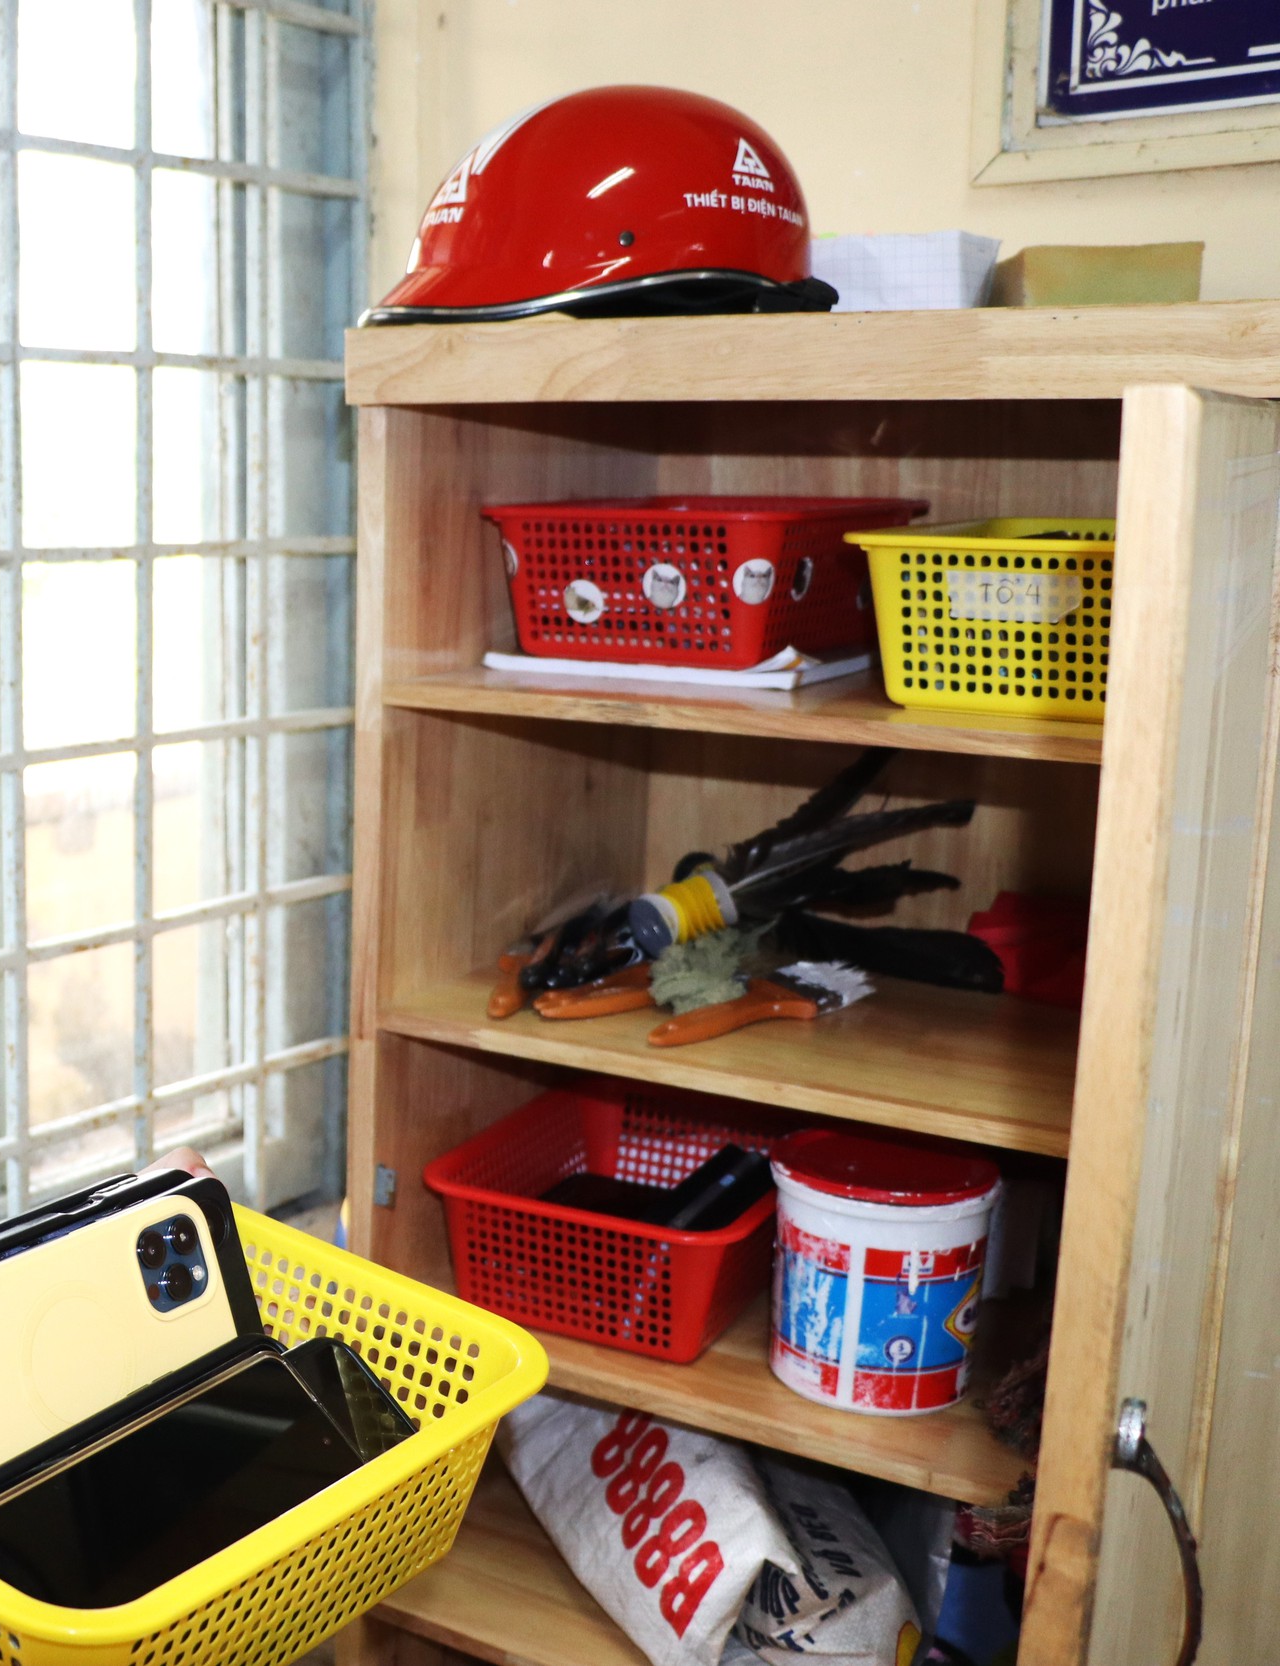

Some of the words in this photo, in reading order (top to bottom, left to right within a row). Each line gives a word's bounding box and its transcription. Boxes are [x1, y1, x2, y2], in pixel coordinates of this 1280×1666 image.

[732, 174, 774, 193] TAIAN
[683, 188, 727, 208] THIẾT
[731, 196, 745, 214] BỊ
[747, 198, 776, 218] ĐIỆN
[1025, 584, 1041, 605] 4
